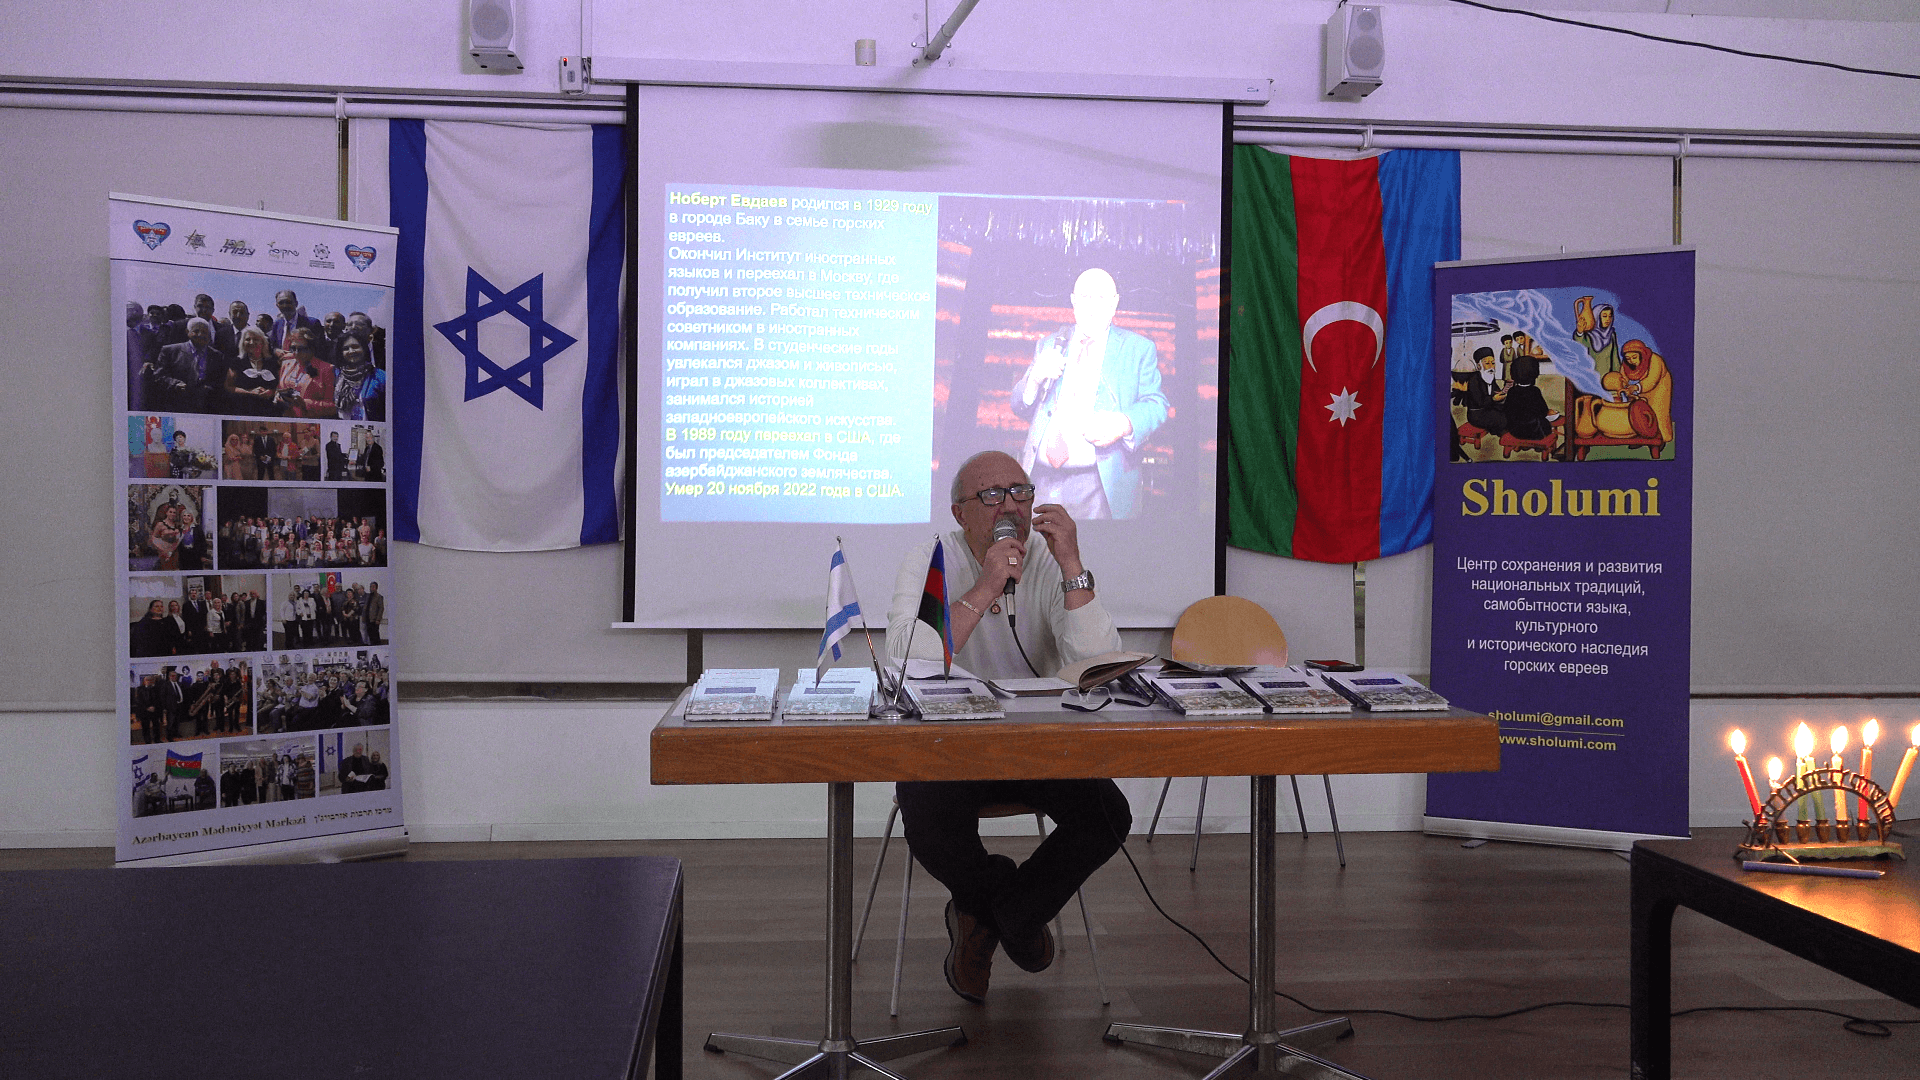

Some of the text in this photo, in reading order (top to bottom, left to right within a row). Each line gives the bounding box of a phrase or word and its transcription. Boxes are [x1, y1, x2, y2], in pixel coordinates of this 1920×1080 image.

[669, 192, 932, 214] Ноберт Евдаев родился в 1929 году
[670, 213, 884, 230] в городе Баку в семье горских
[669, 231, 724, 244] евреев.
[668, 247, 896, 266] Окончил Институт иностранных
[668, 267, 899, 285] языков и переехал в Москву, где
[667, 285, 931, 302] получил второе высшее техническое
[667, 302, 920, 320] образование. Работал техническим
[667, 322, 859, 337] советником в иностранных
[667, 340, 749, 351] компаниях.
[754, 339, 764, 350] В
[768, 341, 862, 356] студенческие
[666, 358, 898, 374] увлекался джазом и живописью,
[666, 376, 889, 392] играл в джазовых коллективах,
[666, 394, 814, 409] занимался историей
[666, 413, 896, 429] западноевропейского искусства.
[666, 428, 901, 446] В 1989 году переехал в США, где
[666, 447, 858, 462] был председателем Фонда
[666, 465, 892, 480] азербайджанского землячества.
[665, 482, 904, 498] Умер 20 ноября 2022 года в США.
[1462, 478, 1661, 516] Sholumi
[1457, 557, 1662, 575] Центр сохранения и развития
[1471, 578, 1645, 596] национальных традиций,
[1484, 598, 1631, 615] самобытности языка,
[1515, 620, 1598, 635] культурного
[1468, 639, 1648, 657] и исторического наследия
[1504, 660, 1608, 676] горских евреев
[1488, 710, 1624, 727] sholumi@gmail.com
[132, 830, 198, 844] Azərbaycan
[265, 816, 306, 828] Mərkəzi
